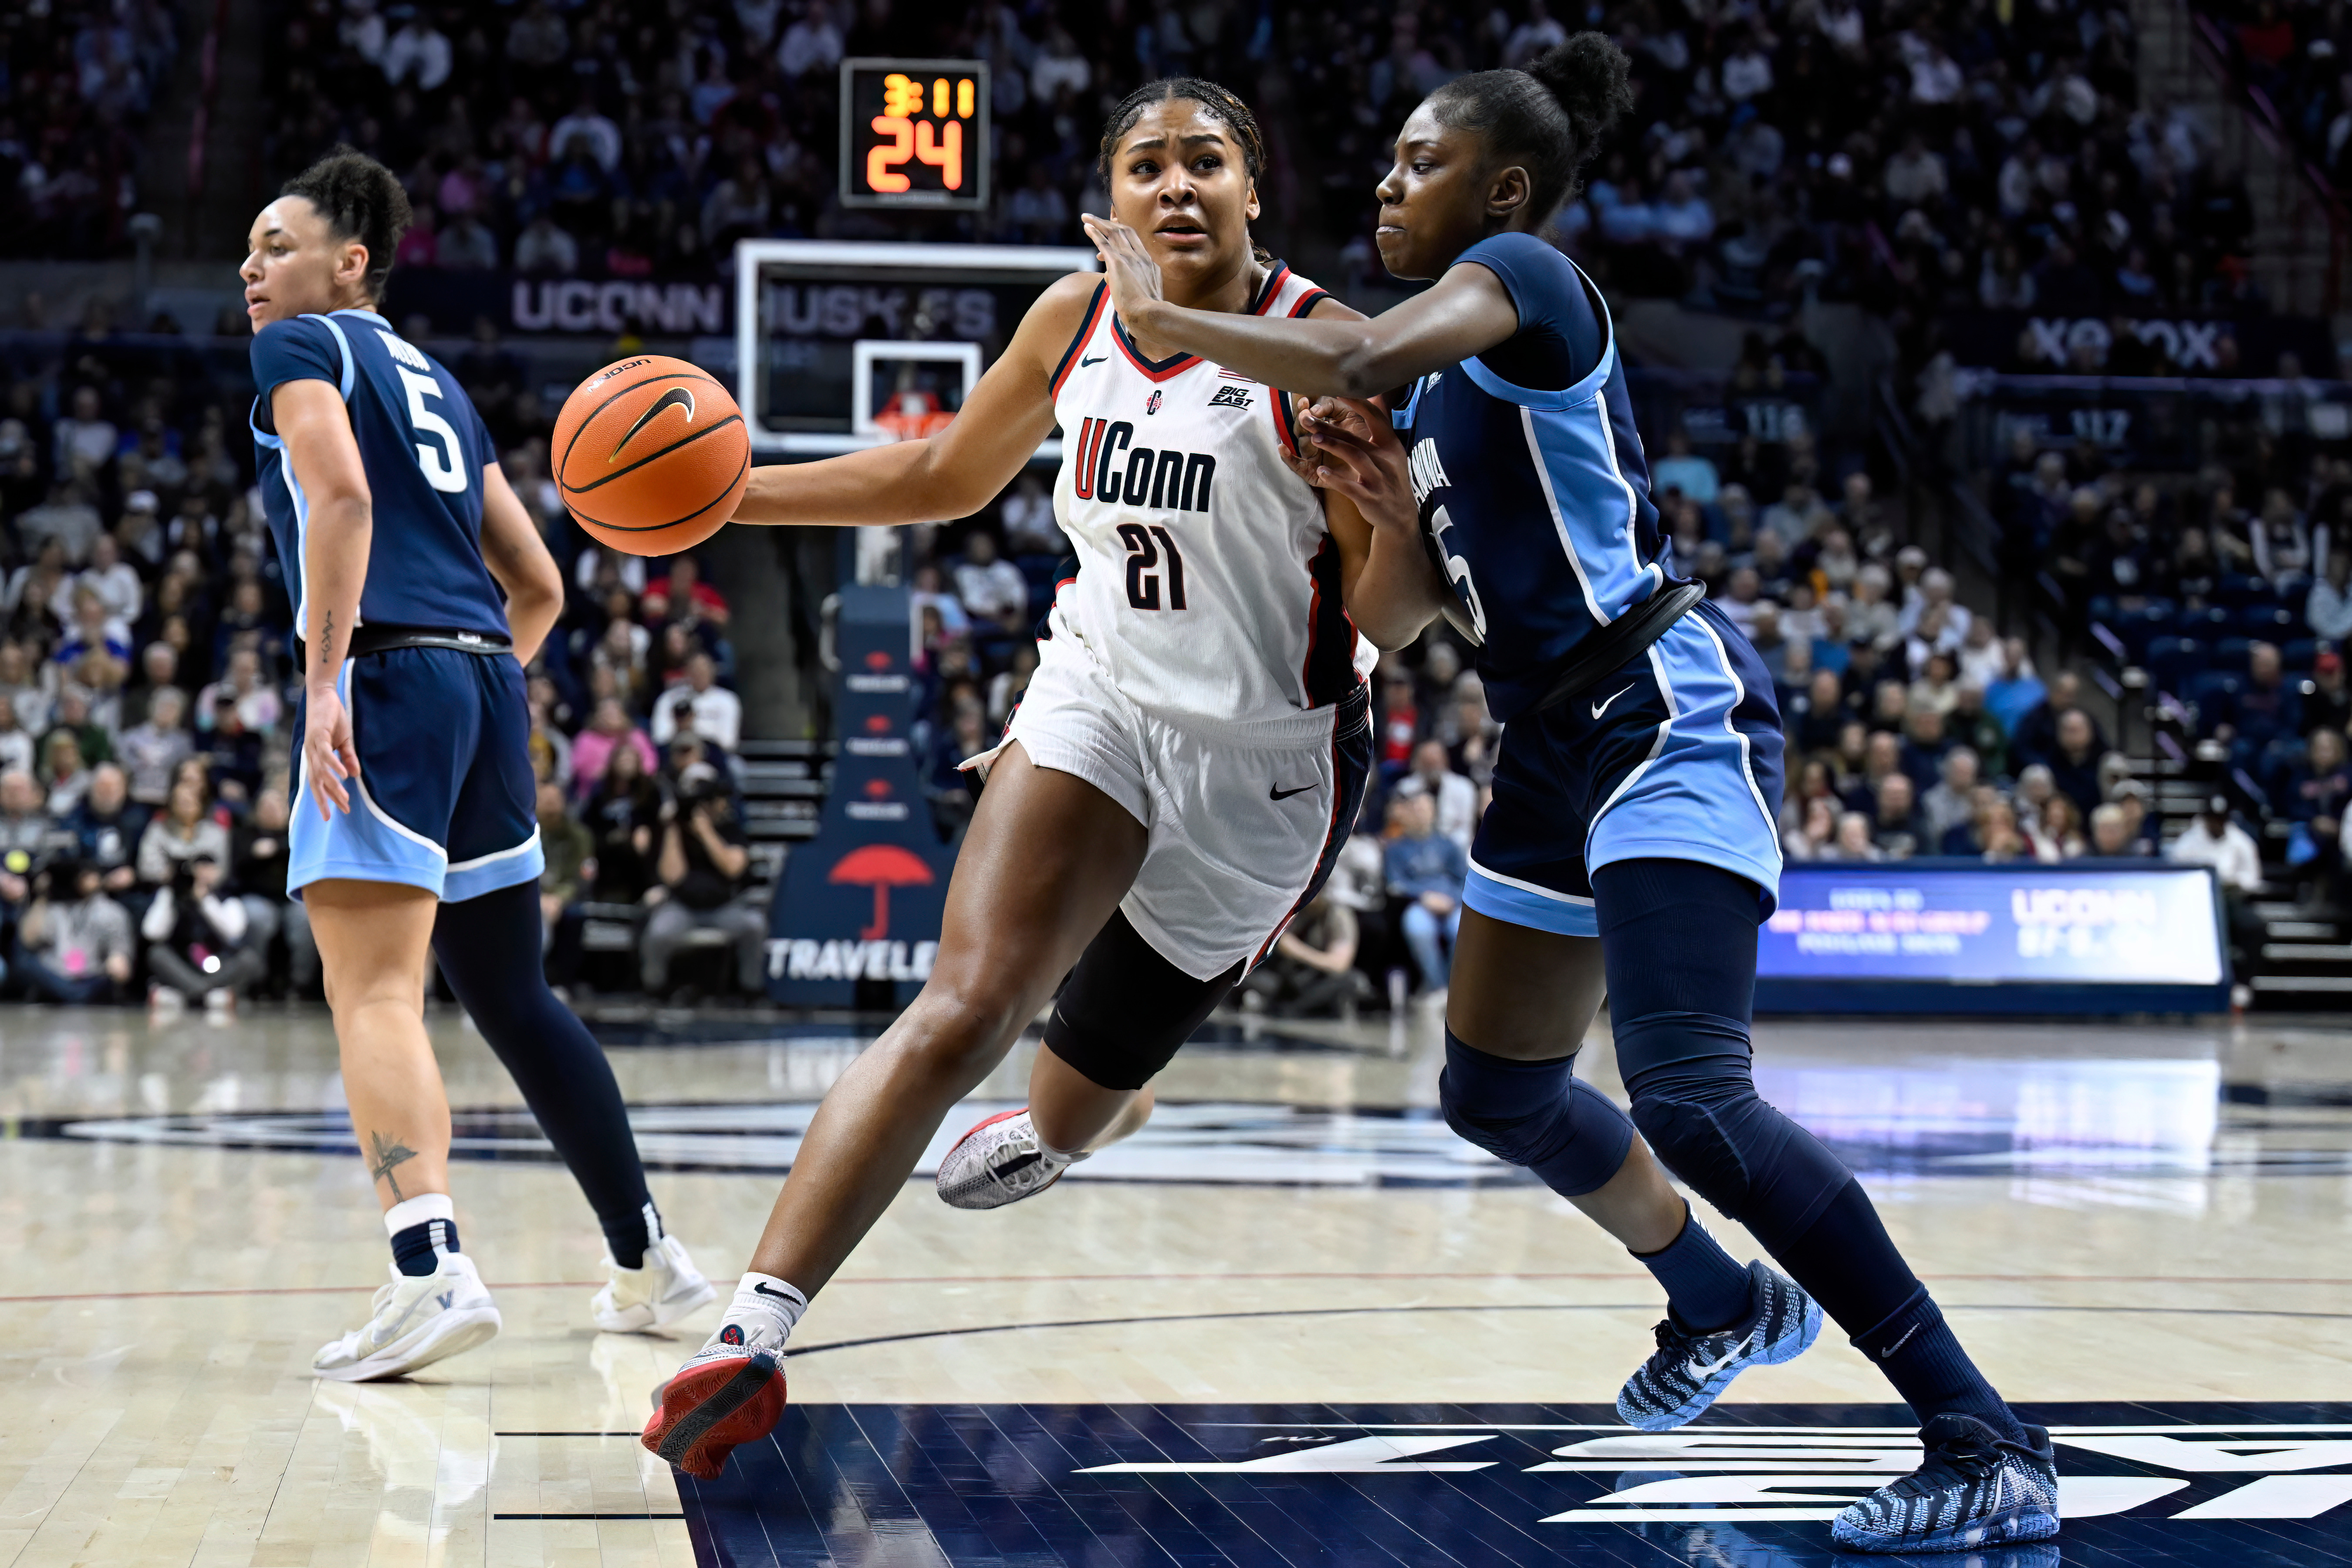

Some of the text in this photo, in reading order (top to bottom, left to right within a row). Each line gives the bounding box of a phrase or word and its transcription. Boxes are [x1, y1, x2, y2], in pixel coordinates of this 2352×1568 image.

[884, 74, 974, 118] 3:11
[867, 115, 962, 193] 24
[512, 279, 724, 333] UCONN
[587, 359, 652, 393] UCONN
[1211, 394, 1254, 406] EAST
[1218, 385, 1250, 397] BIG
[396, 364, 467, 493] 5
[1075, 417, 1216, 513] UConn
[1407, 438, 1452, 514] ANOVA
[1116, 524, 1187, 611] 21
[764, 938, 939, 981] TRAVELE
[1072, 1435, 2352, 1473] AST
[1538, 1474, 2352, 1522] IG
